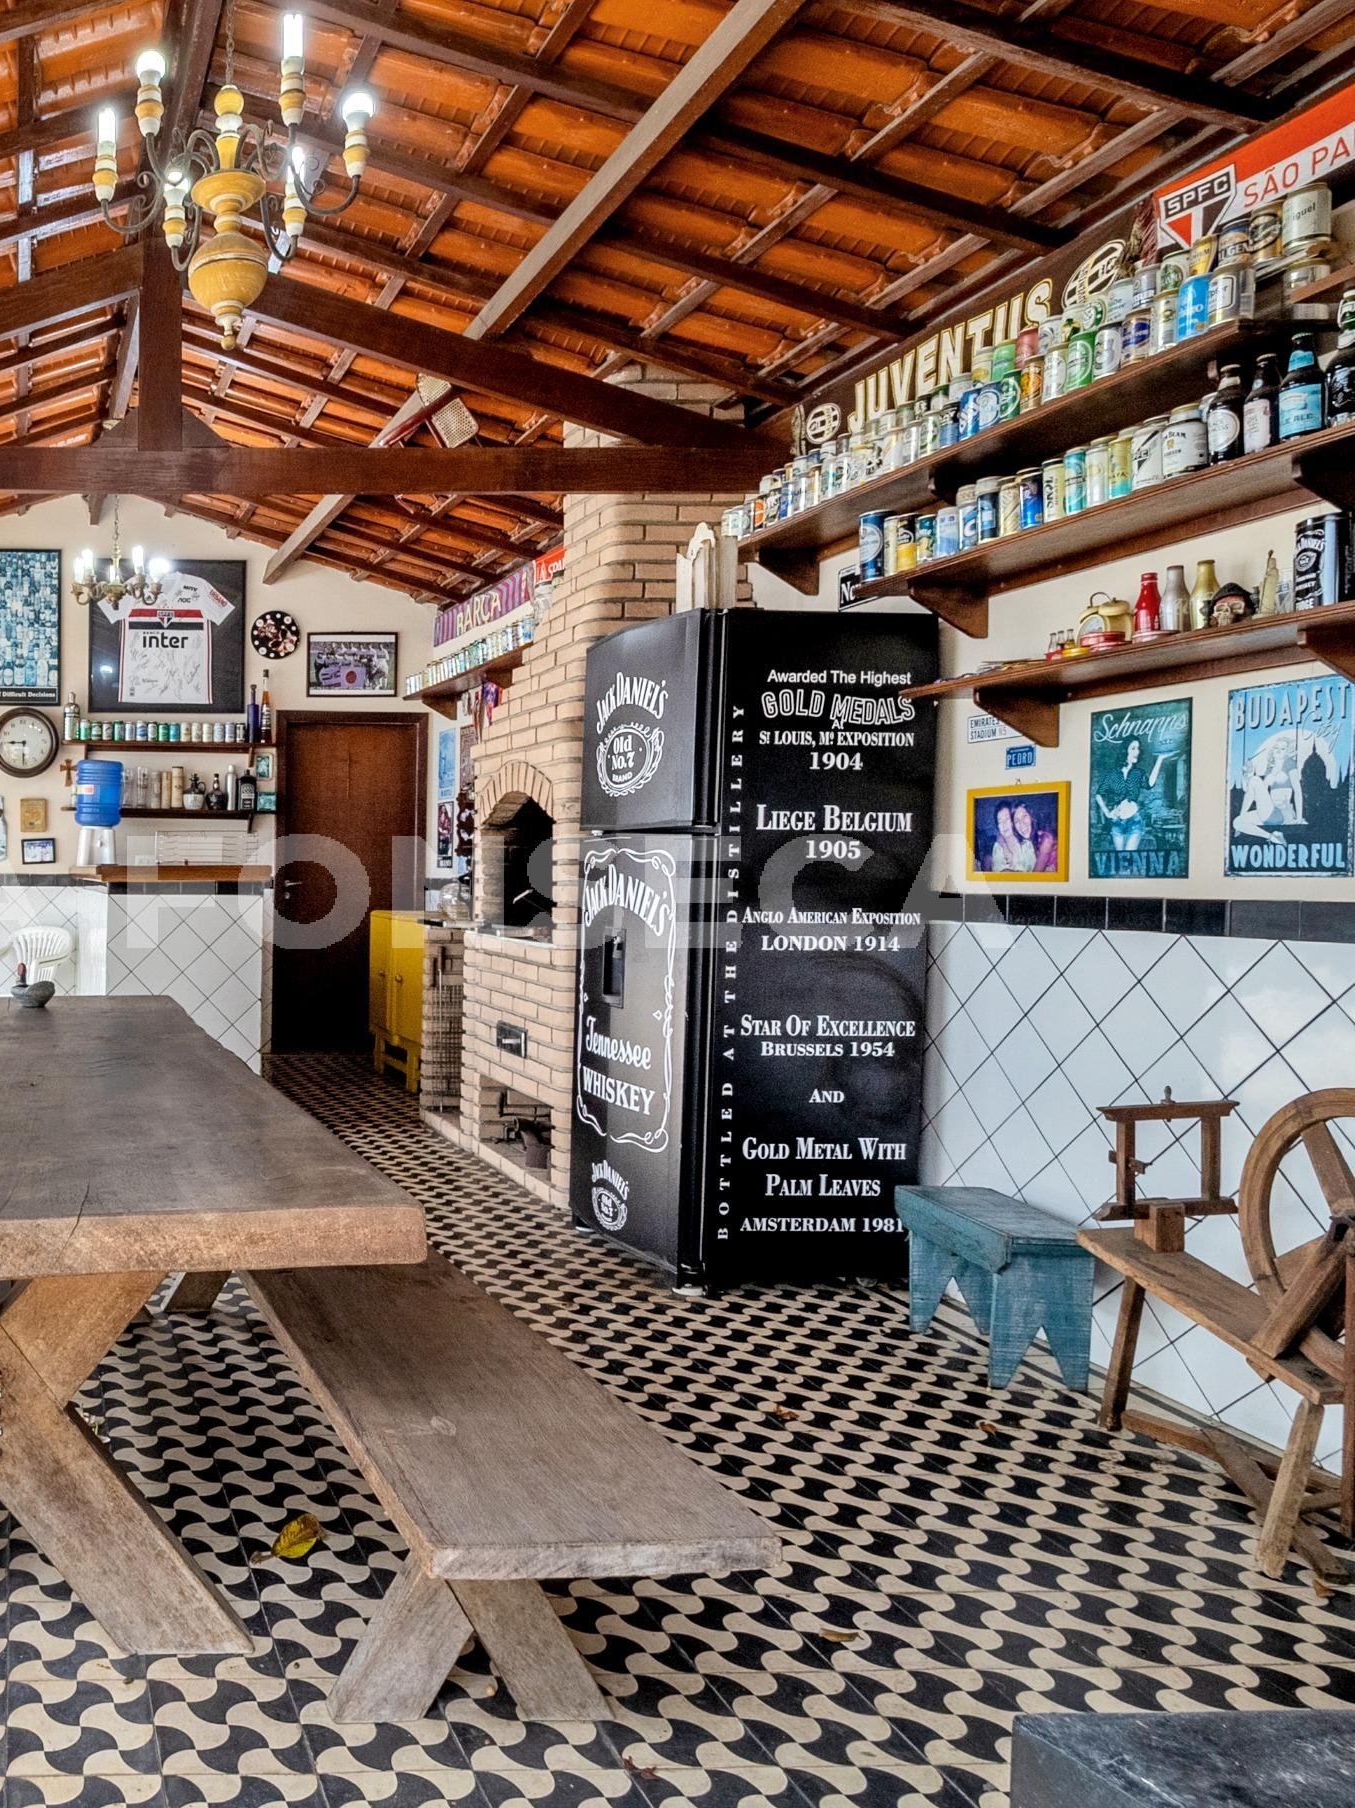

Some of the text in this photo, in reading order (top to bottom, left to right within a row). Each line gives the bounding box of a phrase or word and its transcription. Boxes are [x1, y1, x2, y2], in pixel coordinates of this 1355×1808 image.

[1243, 128, 1355, 209] SÃO PA
[1167, 172, 1232, 215] SPFC
[846, 278, 1054, 436] JUVENTUS
[456, 591, 502, 637] BARÇA
[142, 632, 189, 649] inter
[767, 669, 912, 687] Awarded The Highest
[2, 690, 27, 698] Difficult
[596, 671, 669, 735] JACK DANIEL'S
[761, 688, 916, 726] GOLD MEDALS
[1235, 682, 1351, 732] BUDAPEST
[613, 734, 633, 755] Old
[773, 730, 816, 748] LOUIS,
[836, 731, 915, 747] EXPOSITION
[970, 728, 997, 740] STADIUM
[809, 751, 864, 771] 1904
[1007, 751, 1033, 766] PEDRO
[756, 804, 913, 832] LIEGE BELGIUM
[805, 839, 861, 859] 1905
[1230, 842, 1346, 869] WONDERFUL
[1094, 850, 1184, 877] VIENNA
[584, 863, 671, 937] JACK DANIEL'S
[761, 935, 901, 953] LONDON 1914
[717, 704, 744, 1240] BOTTLED AT THE DISTILLERY
[816, 1015, 916, 1038] EXCELLENCE
[585, 1015, 652, 1071] Tennessee
[760, 1041, 896, 1058] BRUSSELS 1954
[582, 1065, 657, 1116] WHISKEY
[808, 1088, 845, 1104] AND
[740, 1217, 905, 1233] AMSTERDAM 1981
